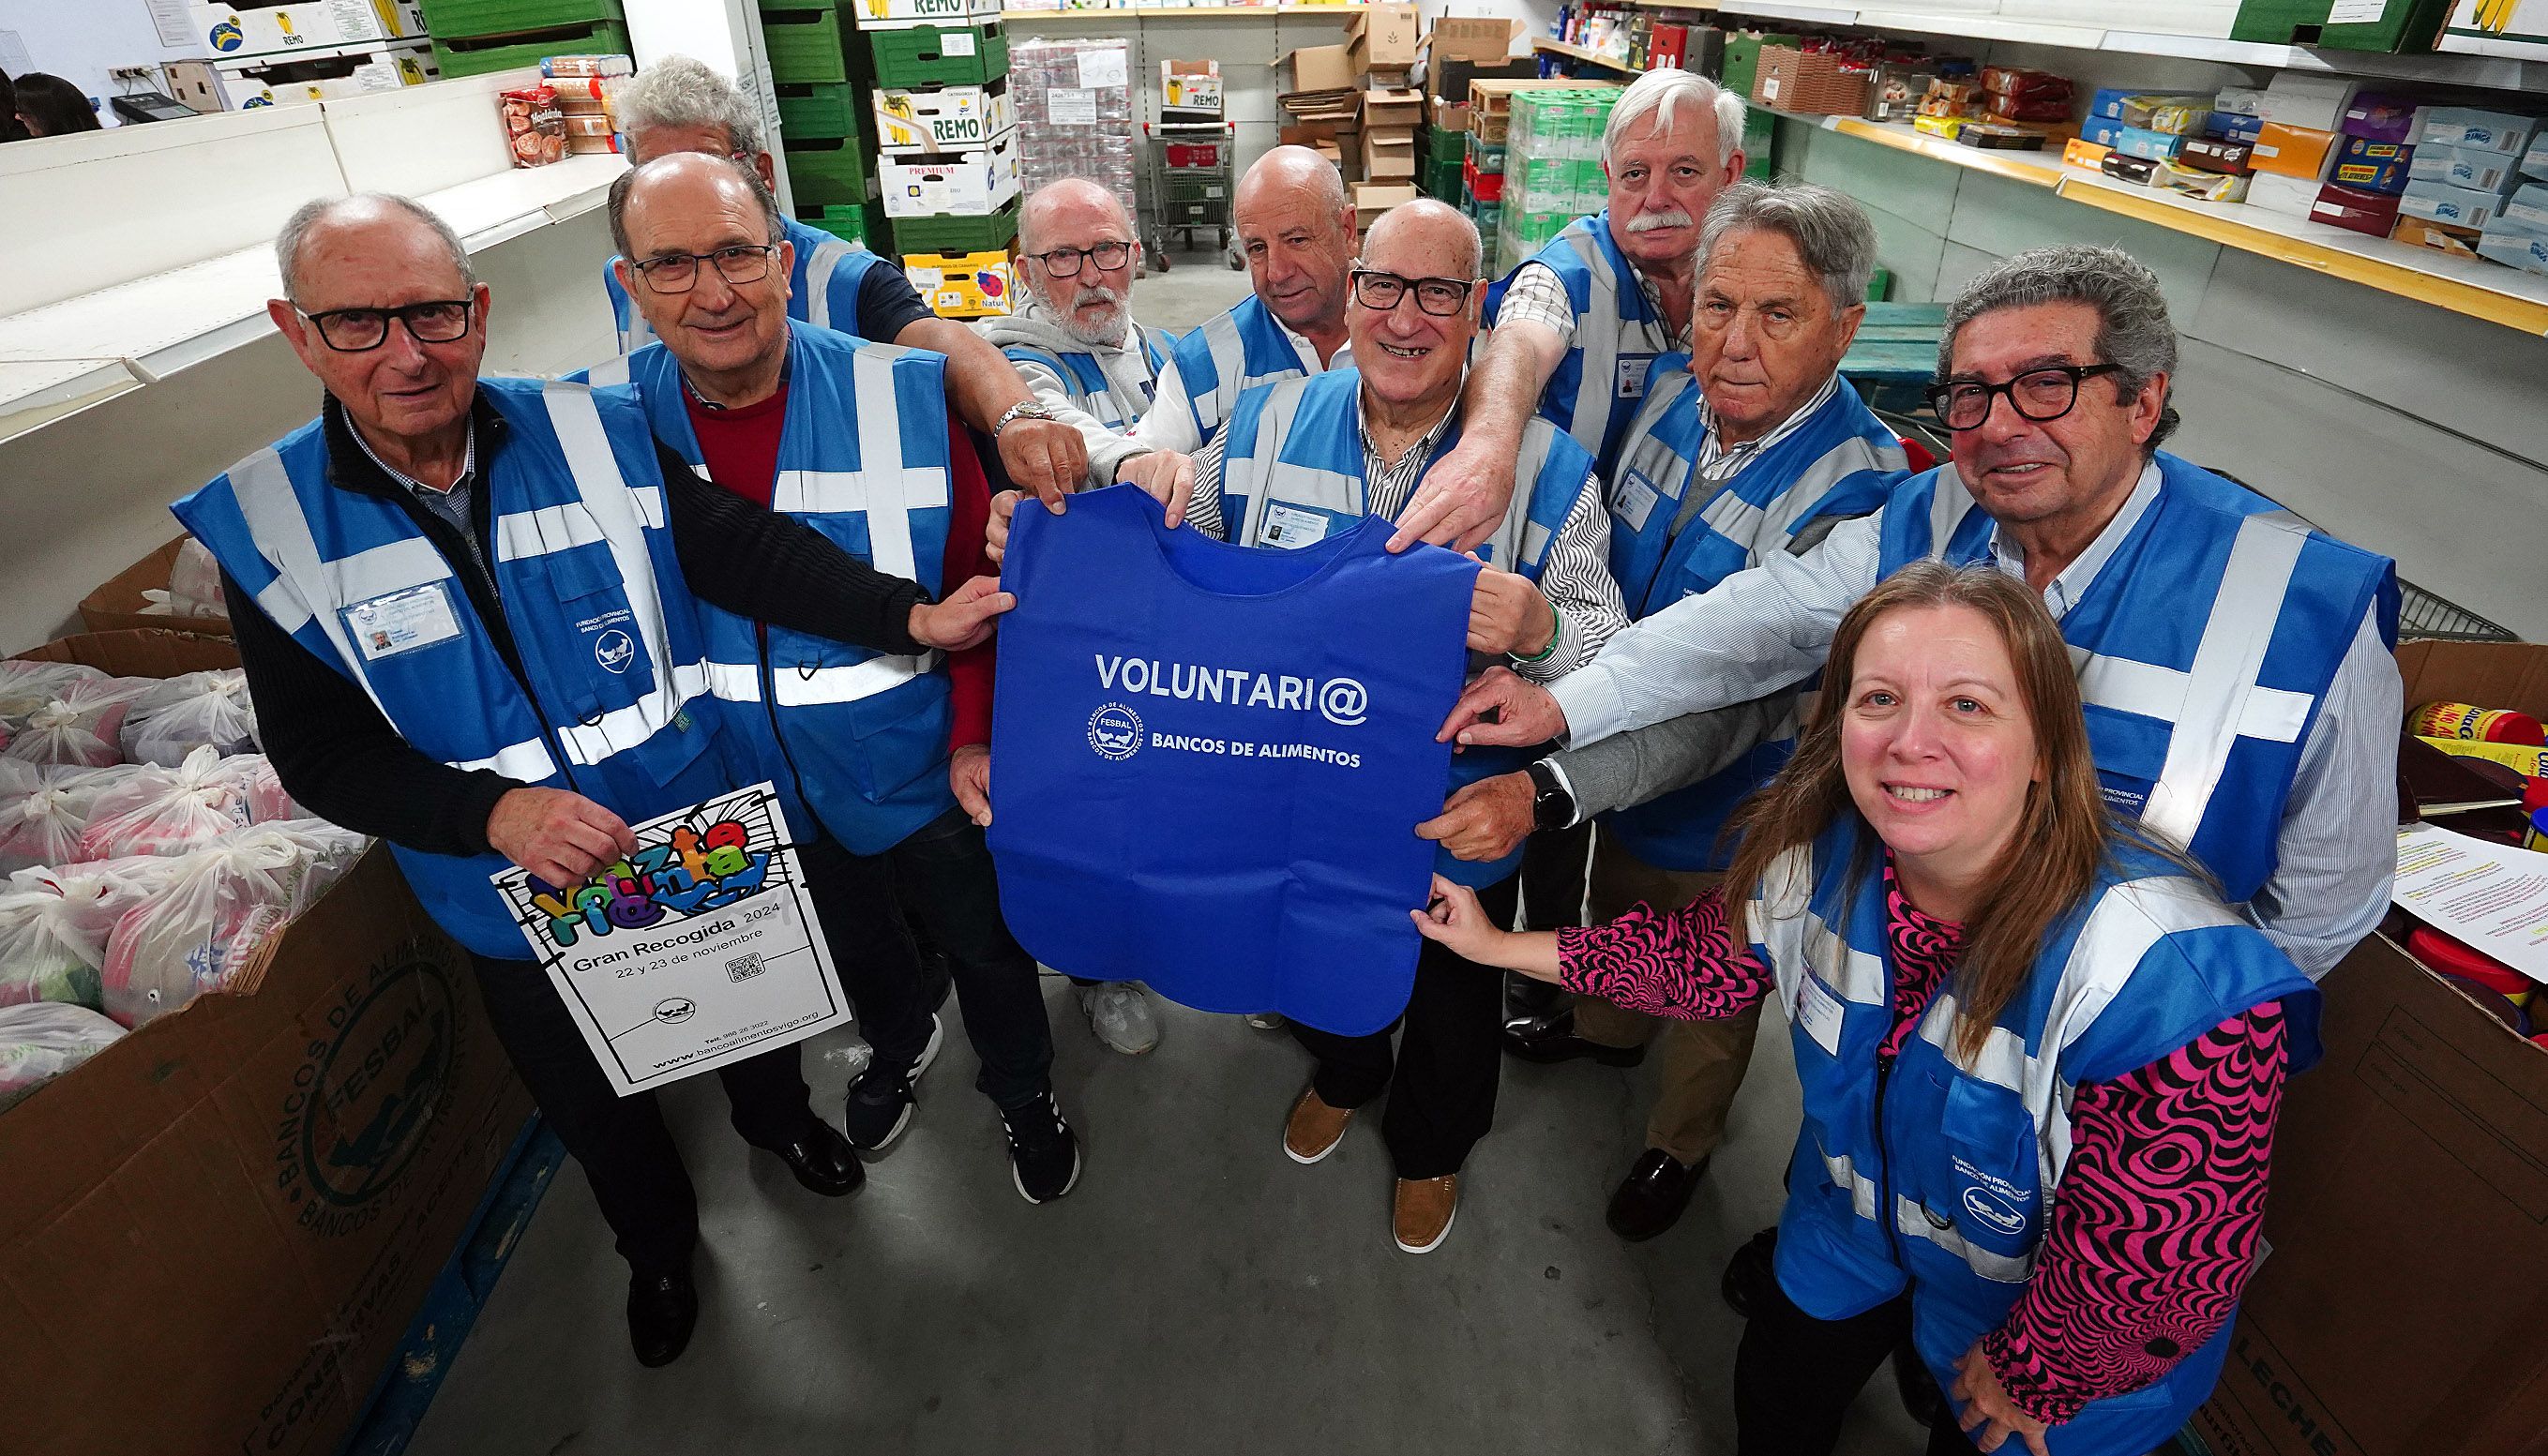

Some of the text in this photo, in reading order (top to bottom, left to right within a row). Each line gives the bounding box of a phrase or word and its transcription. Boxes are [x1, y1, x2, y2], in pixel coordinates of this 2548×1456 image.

[282, 35, 303, 46] REMO
[1193, 95, 1219, 106] REMO
[933, 118, 979, 141] REMO
[2464, 131, 2491, 143] RINGS
[909, 166, 955, 175] PREMIUM
[982, 299, 1005, 308] Natur
[1094, 653, 1368, 726] VOLUNTARI@
[1100, 717, 1132, 729] FESBAL
[1119, 703, 1144, 732] ALIMENTOS
[1115, 738, 1144, 761] ALIMENTOS
[1152, 732, 1361, 769] BANCOS DE ALIMENTOS
[2103, 787, 2145, 801] PROVINCIAL
[573, 952, 629, 972] Gran
[633, 919, 736, 956] Recogida
[744, 903, 780, 923] 2024
[615, 929, 763, 979] 22 y 23 de noviembre
[325, 994, 427, 1113] FESBAL
[276, 1038, 327, 1189] BANCOS
[326, 985, 363, 1029] DE
[1954, 1163, 1980, 1180] BANCO
[1989, 1184, 2030, 1203] ALIMENTOS
[1992, 1177, 2032, 1197] PROVINCIAL
[2235, 1335, 2338, 1456] LECHE
